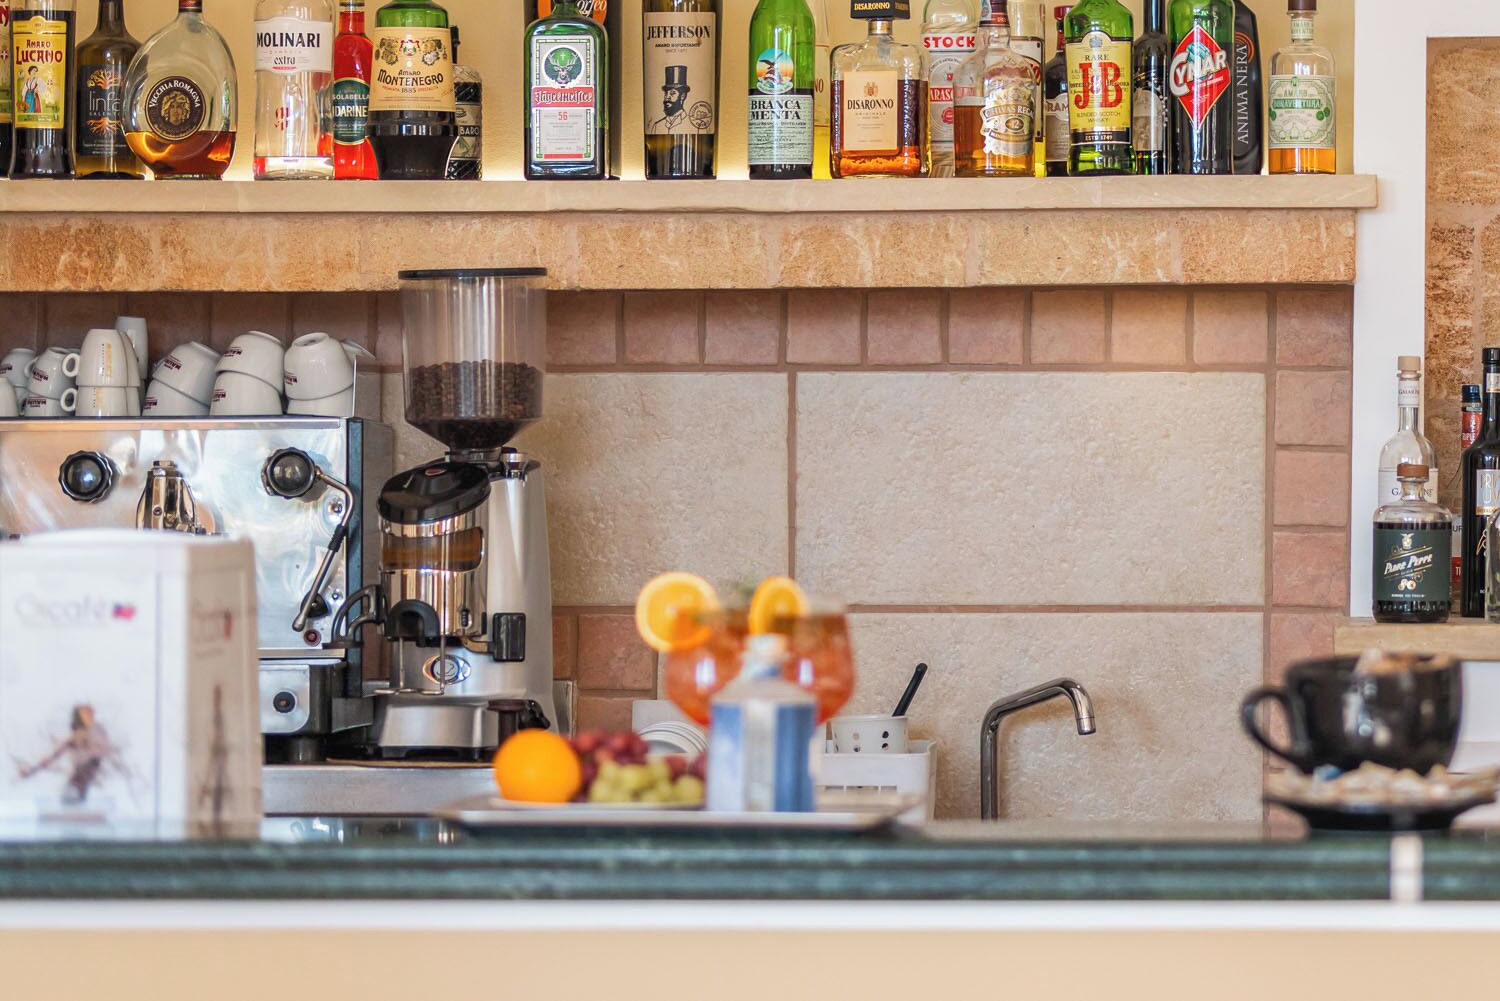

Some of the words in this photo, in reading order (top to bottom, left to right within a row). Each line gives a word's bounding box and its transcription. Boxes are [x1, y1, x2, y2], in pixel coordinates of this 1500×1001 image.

[854, 2, 890, 11] DISARONNO
[256, 32, 320, 48] MOLINARI
[646, 25, 710, 41] JEFFERSON
[26, 39, 51, 48] AMARO
[924, 36, 975, 48] STOCK
[16, 47, 64, 65] LUCANO
[274, 55, 296, 65] extra
[1170, 49, 1226, 96] CYNAR
[1238, 45, 1248, 93] NERA
[378, 69, 444, 86] MONTENEGRO
[1074, 61, 1123, 109] J&B
[149, 80, 173, 108] VECCHIA
[174, 80, 201, 108] ROMAGNA
[751, 100, 801, 110] BRANCA
[848, 98, 894, 110] DISARONNO
[558, 112, 568, 120] 56
[750, 111, 801, 120] MENTA
[1238, 94, 1248, 144] ANIMA
[1384, 562, 1407, 574] PADRE
[1408, 554, 1433, 567] PEPPE
